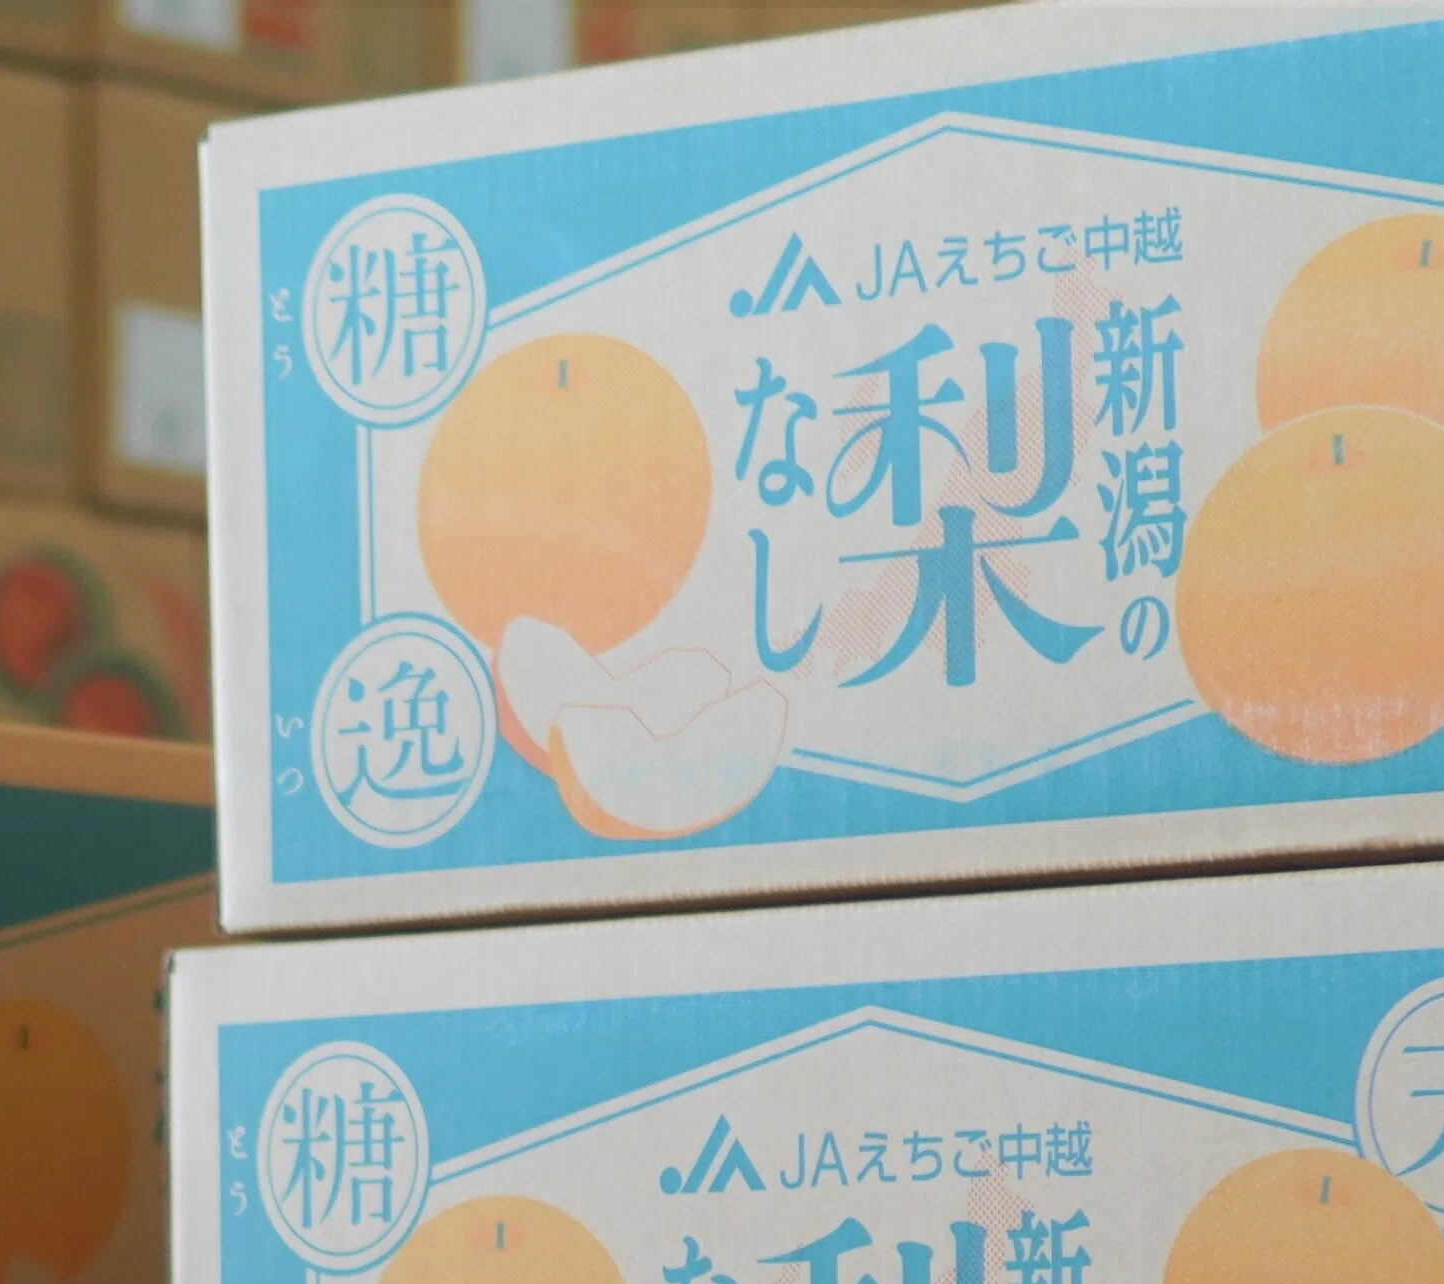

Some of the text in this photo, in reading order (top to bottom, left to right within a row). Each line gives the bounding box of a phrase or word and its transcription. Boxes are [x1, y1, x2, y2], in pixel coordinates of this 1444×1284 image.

[329, 234, 459, 387] 糖
[856, 206, 1183, 301] JAえちご中越
[735, 358, 822, 678] なし
[826, 316, 1106, 689] 梨
[1093, 294, 1186, 660] 新潟の
[336, 662, 471, 805] 逸
[282, 1081, 405, 1229] 糖
[779, 1121, 1093, 1189] JAえちご中越
